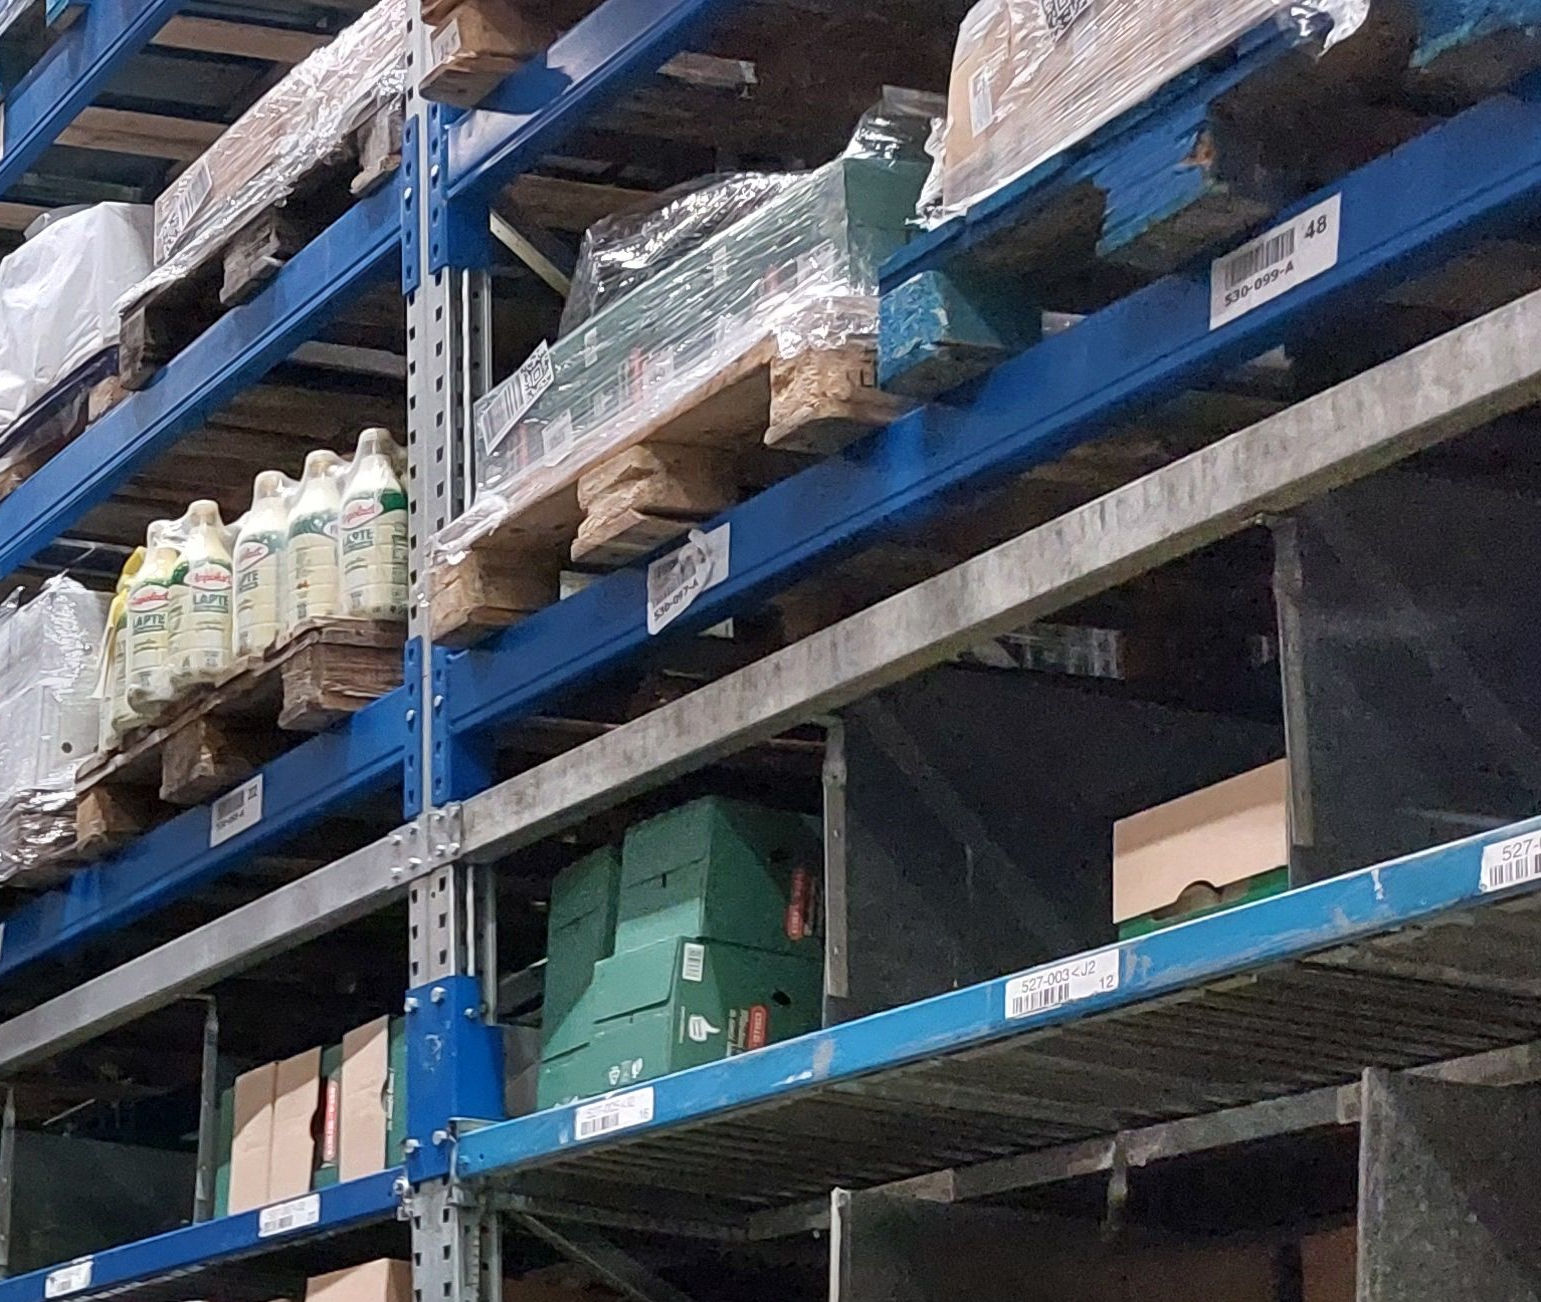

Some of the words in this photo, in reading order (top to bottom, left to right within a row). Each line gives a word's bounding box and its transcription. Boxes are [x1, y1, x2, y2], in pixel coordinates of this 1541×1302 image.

[1304, 214, 1327, 239] 48
[1224, 260, 1294, 307] 530-099-A
[1502, 837, 1541, 862] 527-
[1021, 961, 1096, 993] 527-003<J2
[1100, 975, 1114, 989] 12
